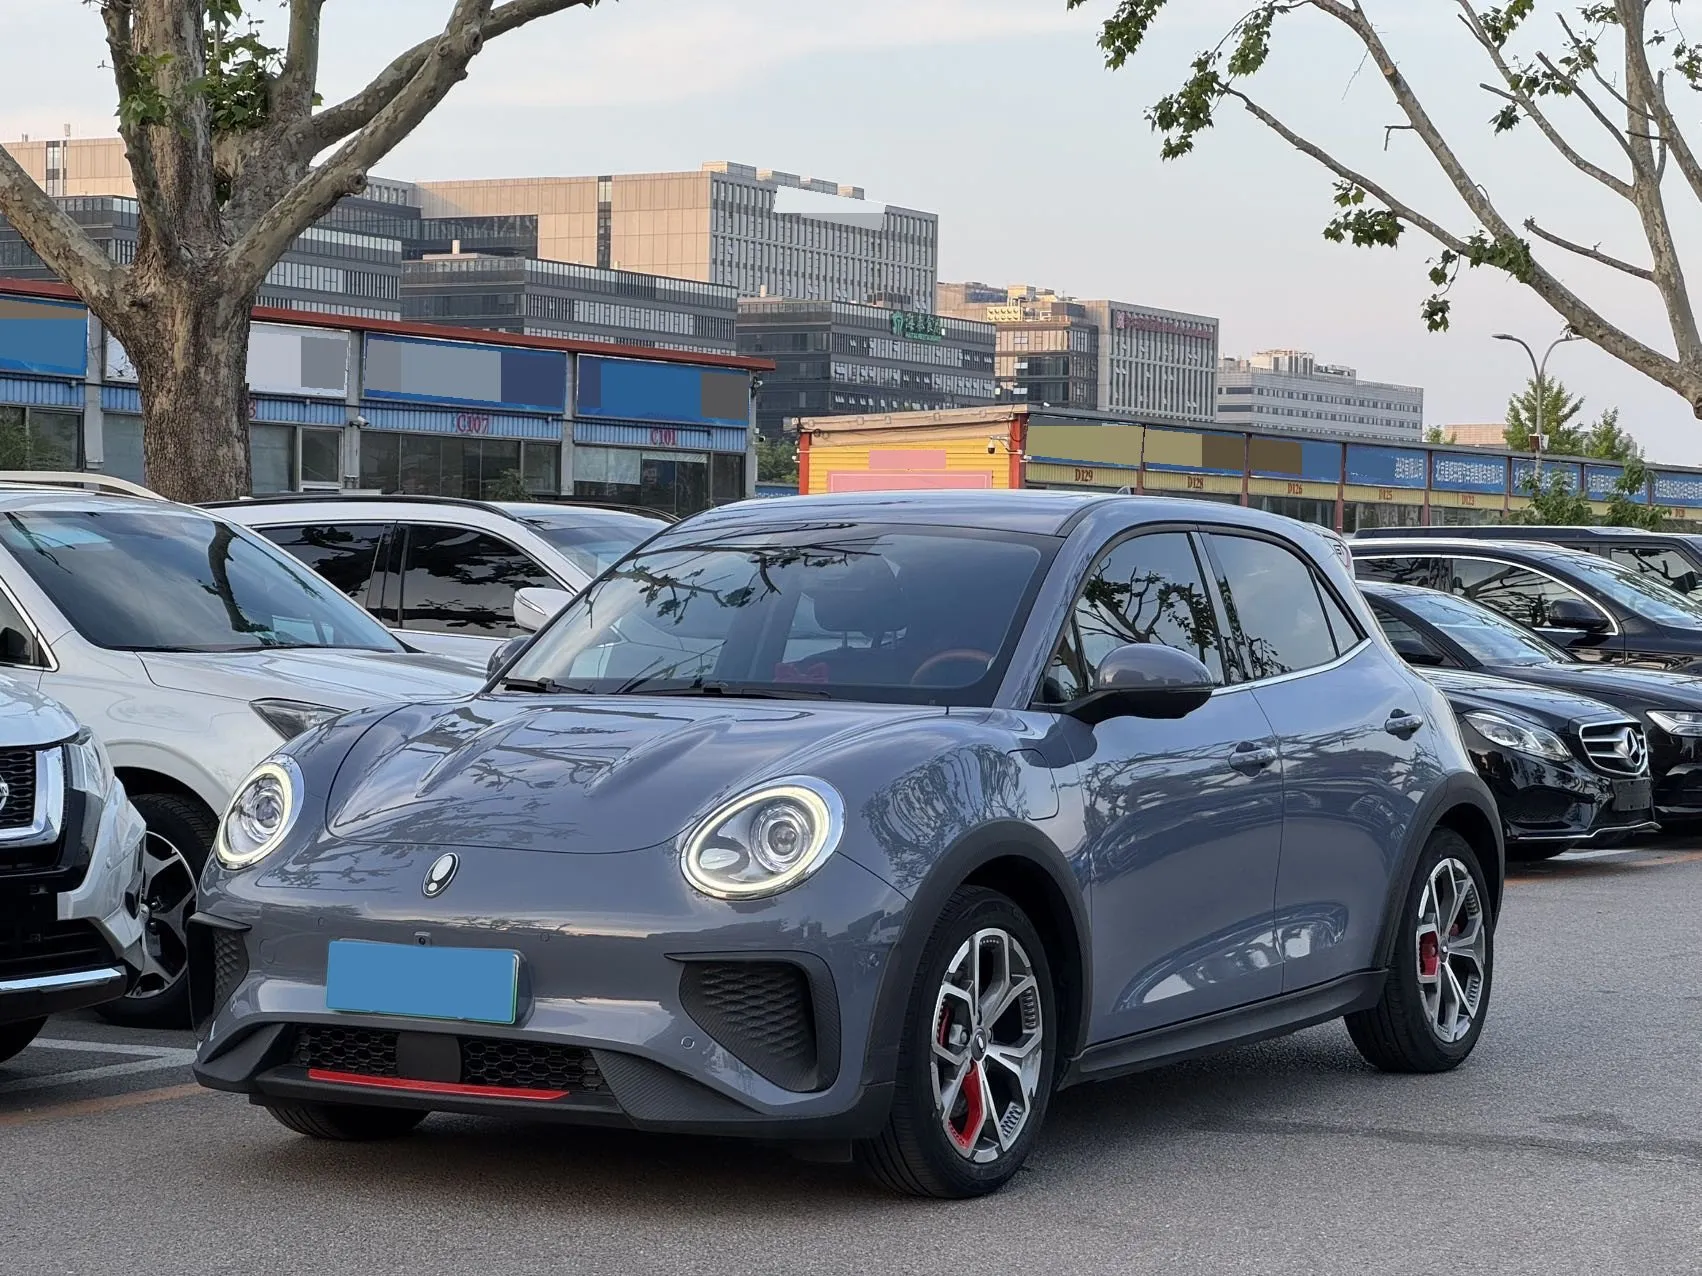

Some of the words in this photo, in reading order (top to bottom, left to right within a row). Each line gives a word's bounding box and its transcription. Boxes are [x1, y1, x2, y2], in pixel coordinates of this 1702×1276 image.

[456, 413, 490, 433] C107
[650, 427, 676, 446] C101
[1075, 468, 1094, 482] D129
[1187, 475, 1204, 489] D128
[1287, 482, 1303, 495] D126
